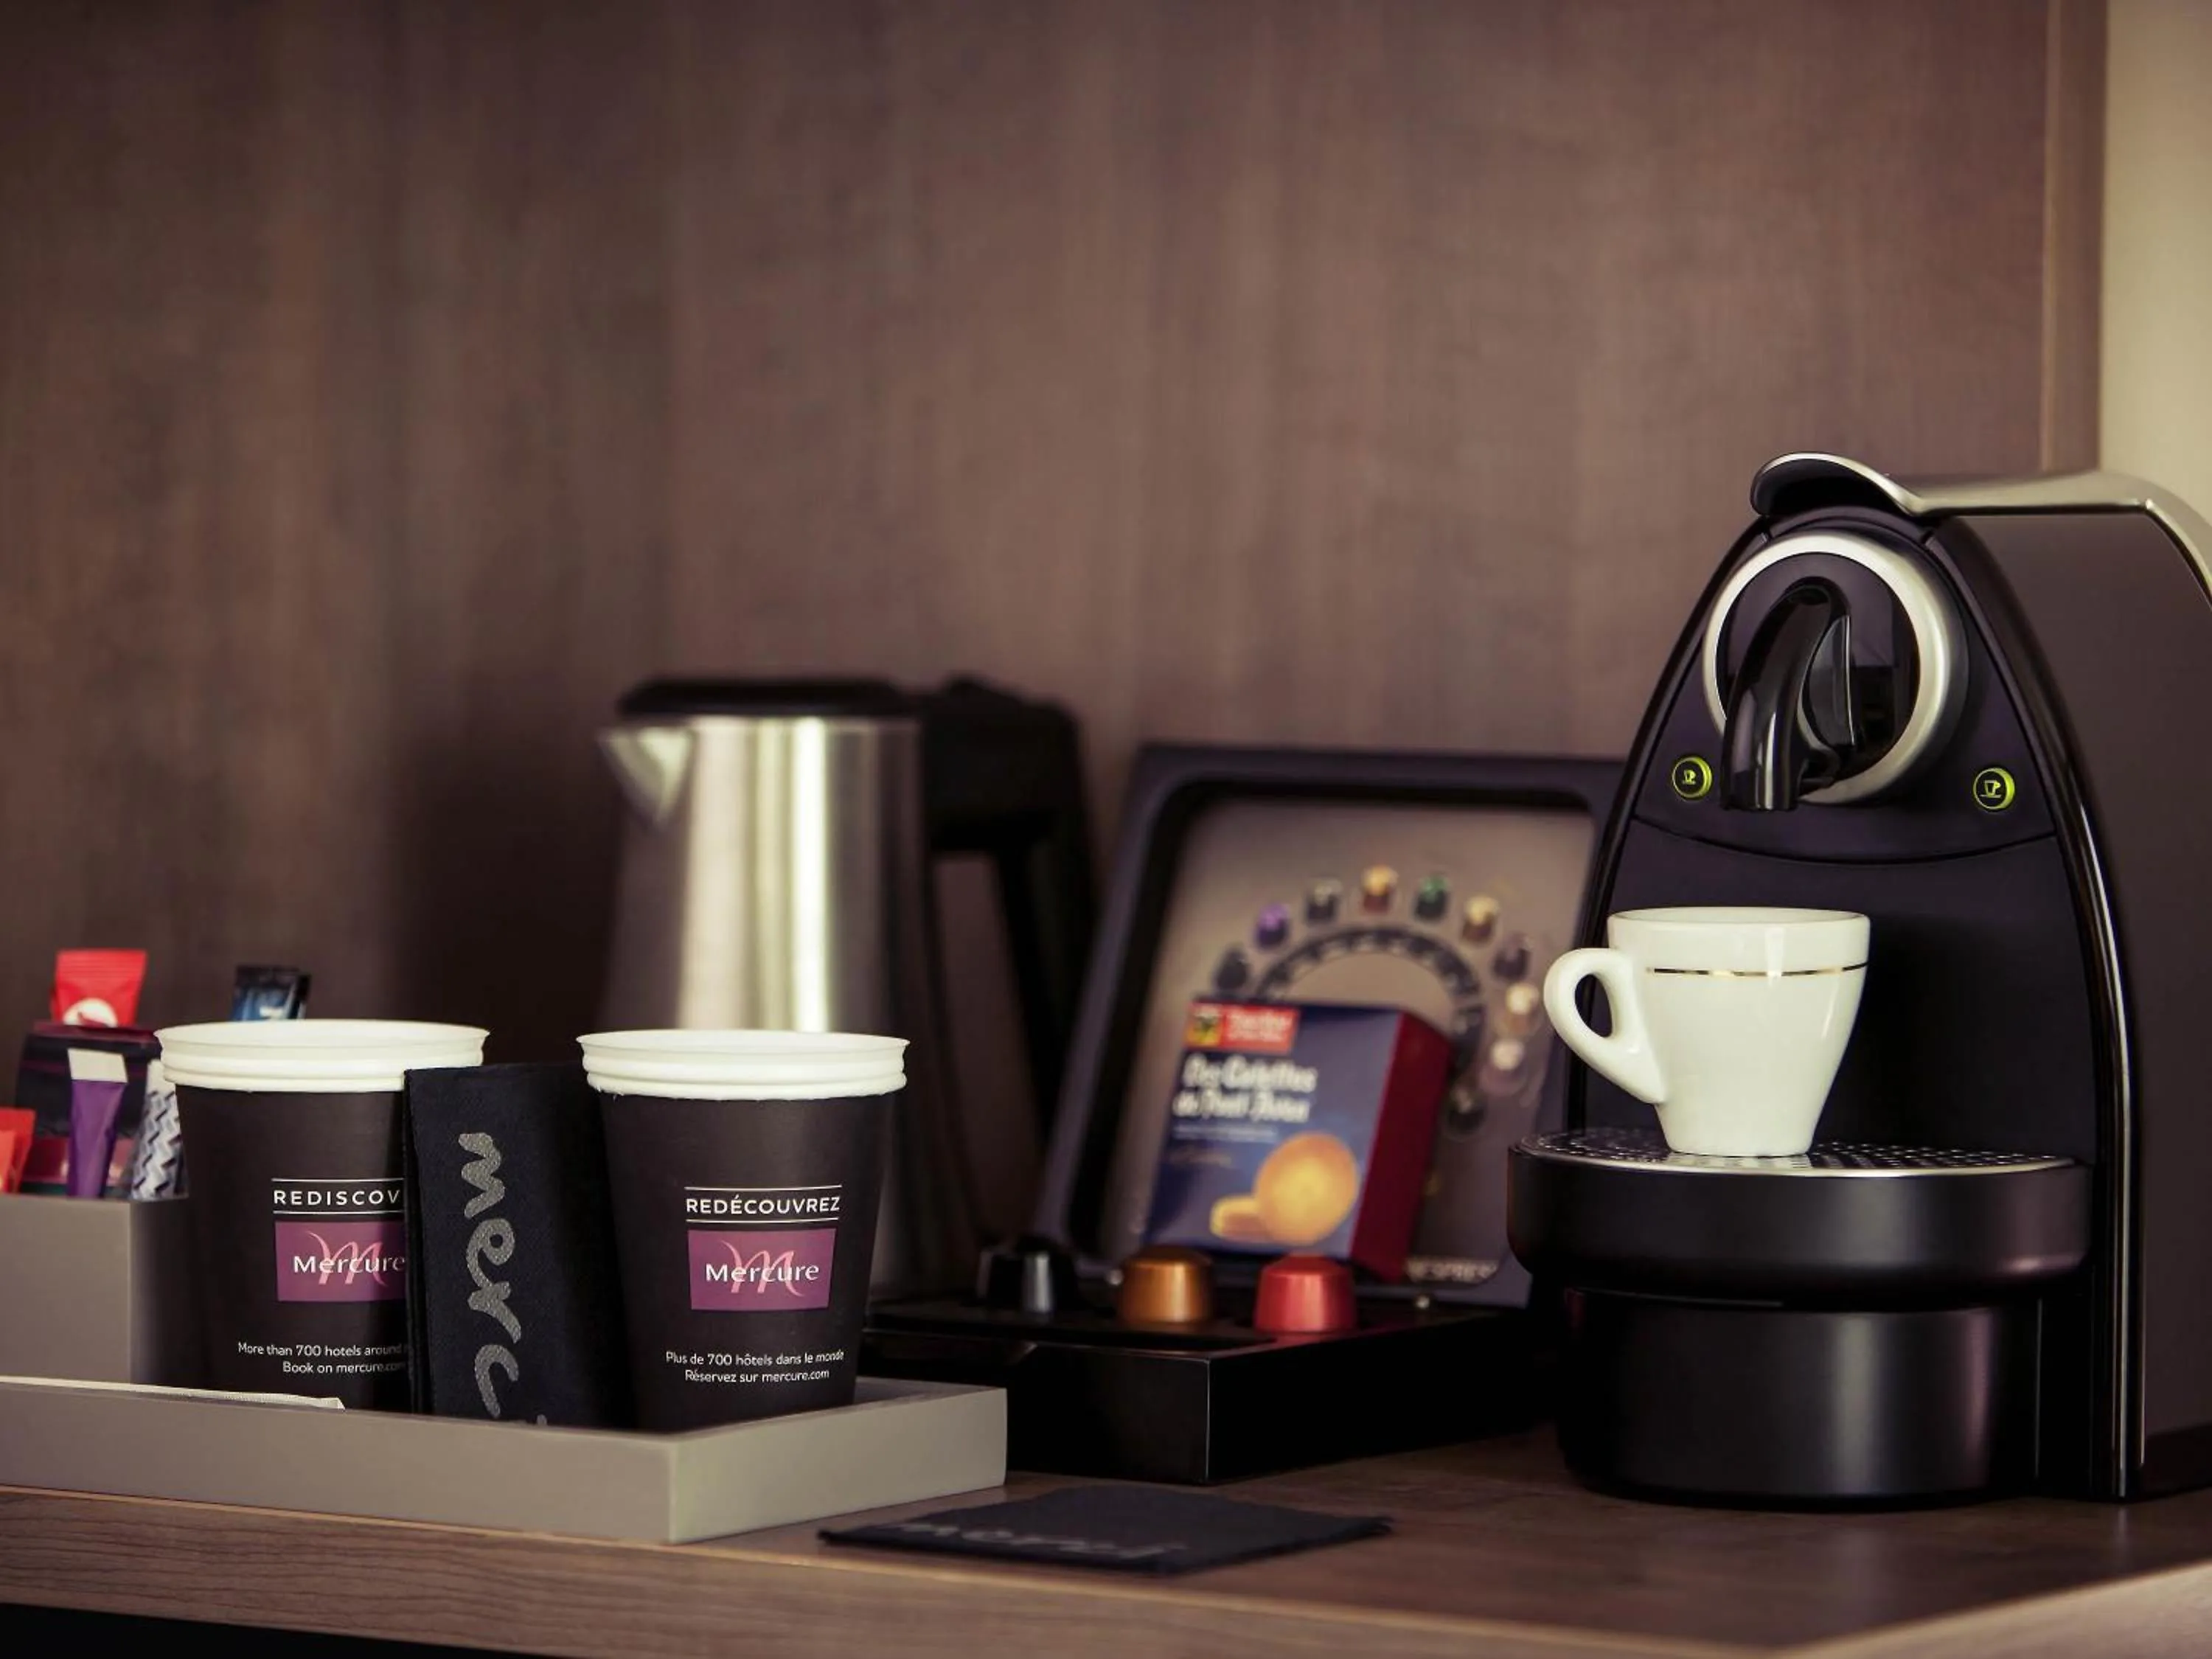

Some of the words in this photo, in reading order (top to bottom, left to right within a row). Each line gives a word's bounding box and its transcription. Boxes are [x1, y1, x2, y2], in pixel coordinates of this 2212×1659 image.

[274, 1189, 400, 1206] REDISCOV
[686, 1194, 841, 1214] REDÉCOUVREZ
[293, 1255, 406, 1274] Mercure
[705, 1263, 820, 1282] Mercure
[458, 1132, 547, 1425] merc
[237, 1341, 264, 1354] More
[266, 1343, 293, 1357] than
[296, 1344, 321, 1357] 700
[324, 1344, 361, 1357] hotels
[364, 1343, 402, 1356] around
[666, 1351, 688, 1364] Plus
[690, 1352, 704, 1365] de
[707, 1354, 732, 1366] 700
[735, 1353, 773, 1366] hôtels
[776, 1352, 801, 1365] dans
[804, 1351, 813, 1363] le
[815, 1349, 844, 1362] monde
[282, 1361, 313, 1374] Book
[318, 1364, 333, 1374] on
[685, 1368, 737, 1383] Réservez
[740, 1373, 759, 1383] sur
[762, 1369, 830, 1382] mercure.com
